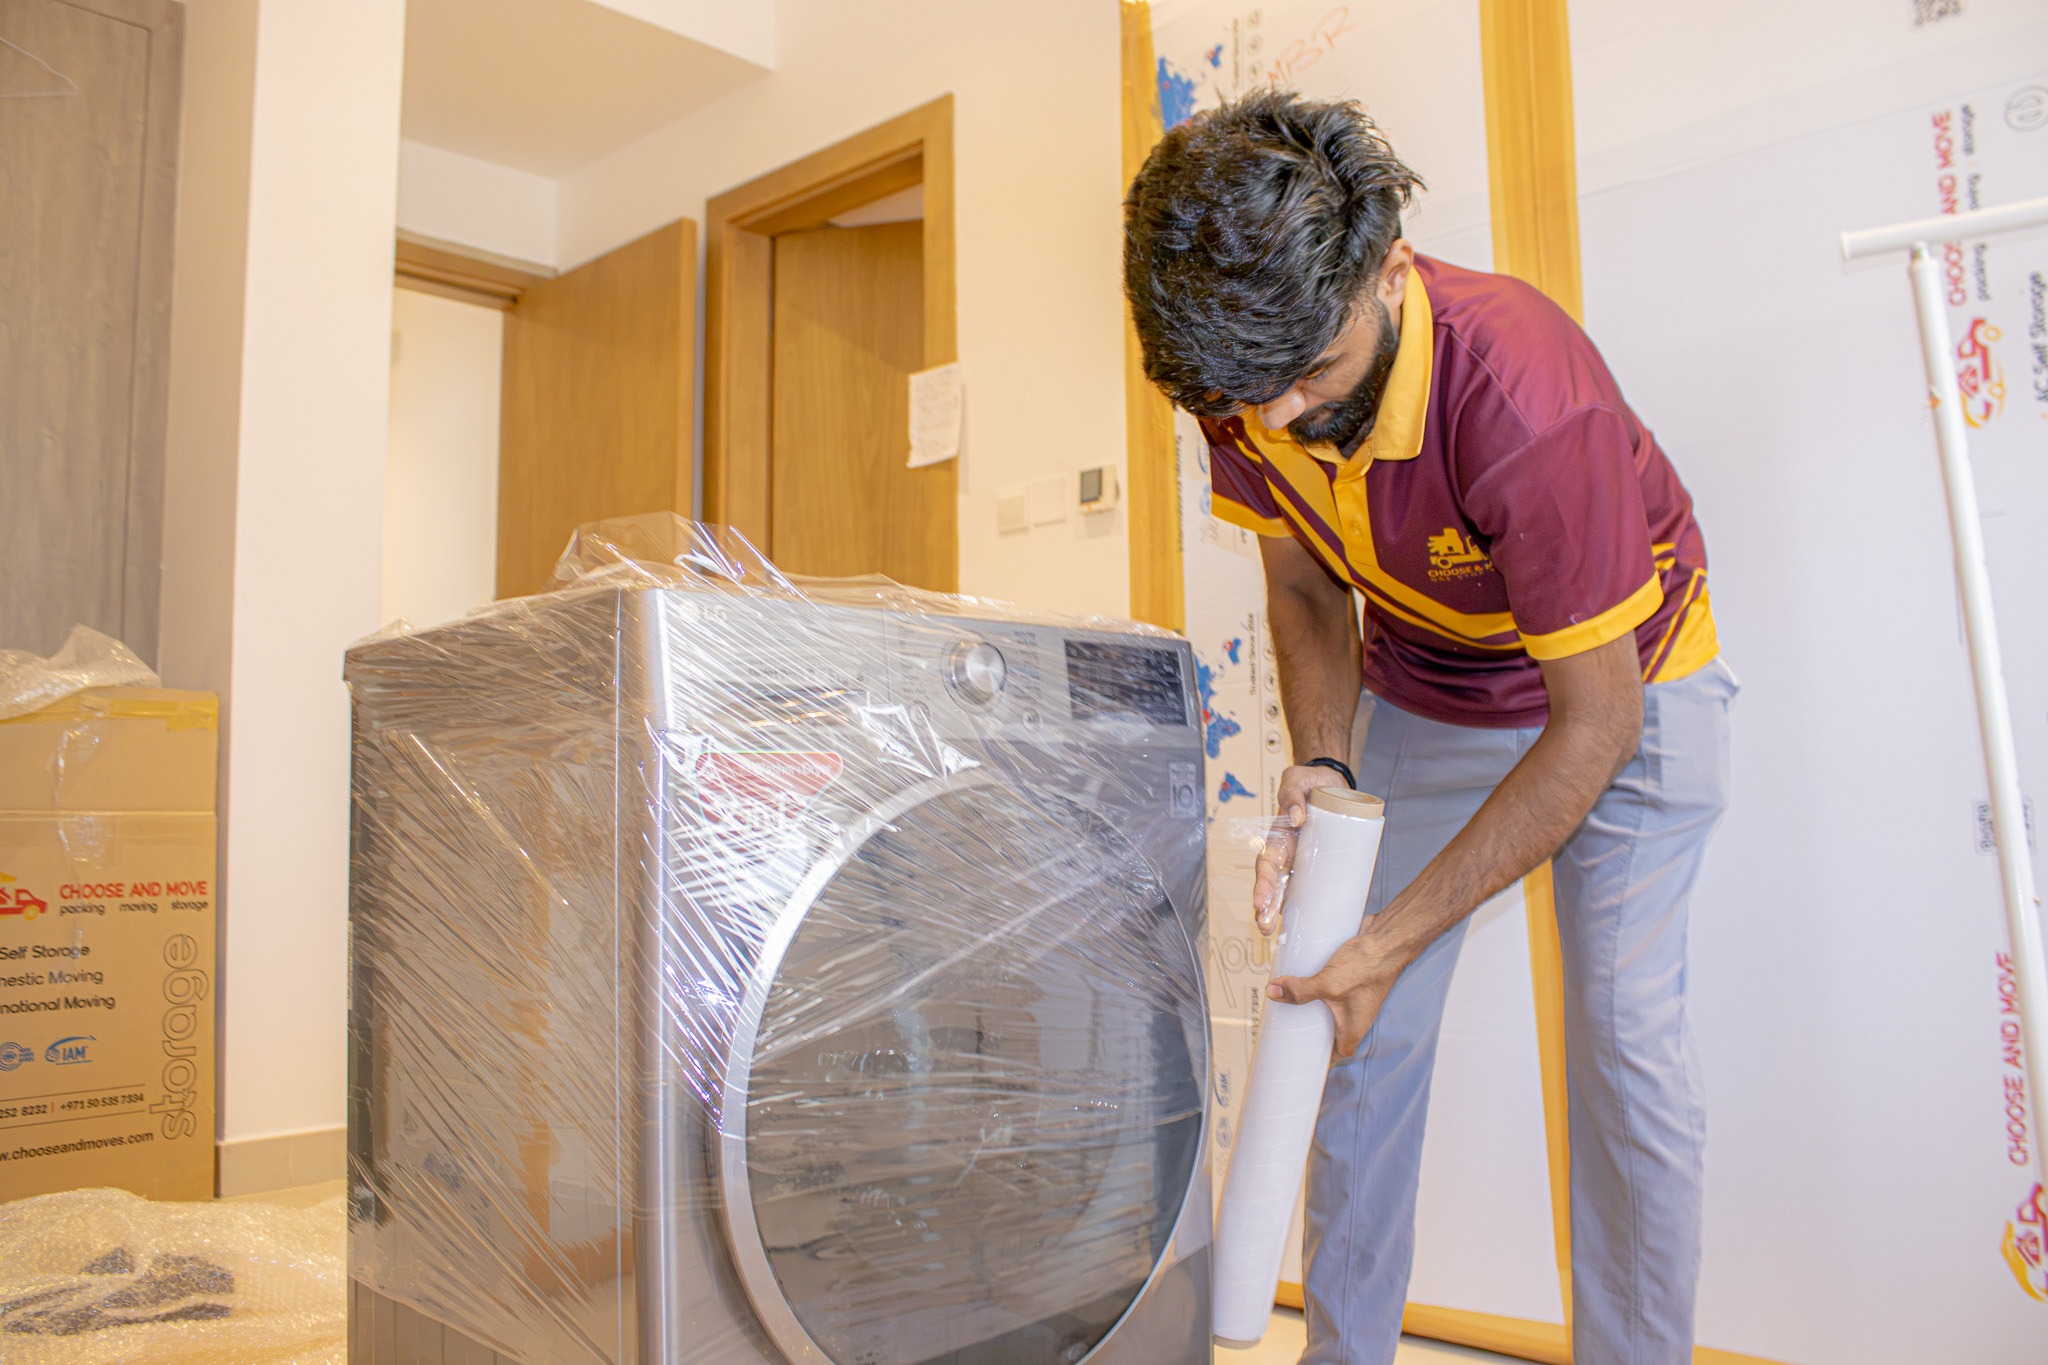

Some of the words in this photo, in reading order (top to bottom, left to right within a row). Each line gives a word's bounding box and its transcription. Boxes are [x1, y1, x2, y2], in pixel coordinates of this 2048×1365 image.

[1932, 110, 1953, 170] MOVE
[1937, 173, 1957, 215] AND
[1968, 173, 1981, 211] oving
[1944, 240, 1966, 306] CHOOS
[2028, 271, 2048, 339] Storage
[59, 883, 125, 900] CHOOSE
[129, 882, 162, 897] AND
[166, 881, 208, 896] MOVE
[60, 902, 105, 917] packing
[119, 901, 158, 914] moving
[171, 900, 209, 912] storage
[0, 945, 27, 960] Self
[32, 944, 90, 960] Storage
[48, 970, 104, 985] Moving
[64, 995, 116, 1010] Moving
[62, 1045, 87, 1061] IAM
[149, 933, 209, 1140] storage
[2001, 1020, 2023, 1070] AND
[21, 1104, 47, 1116] 8232
[60, 1100, 85, 1111] +971
[86, 1098, 99, 1108] 50
[2004, 1073, 2029, 1167] CHOOSE
